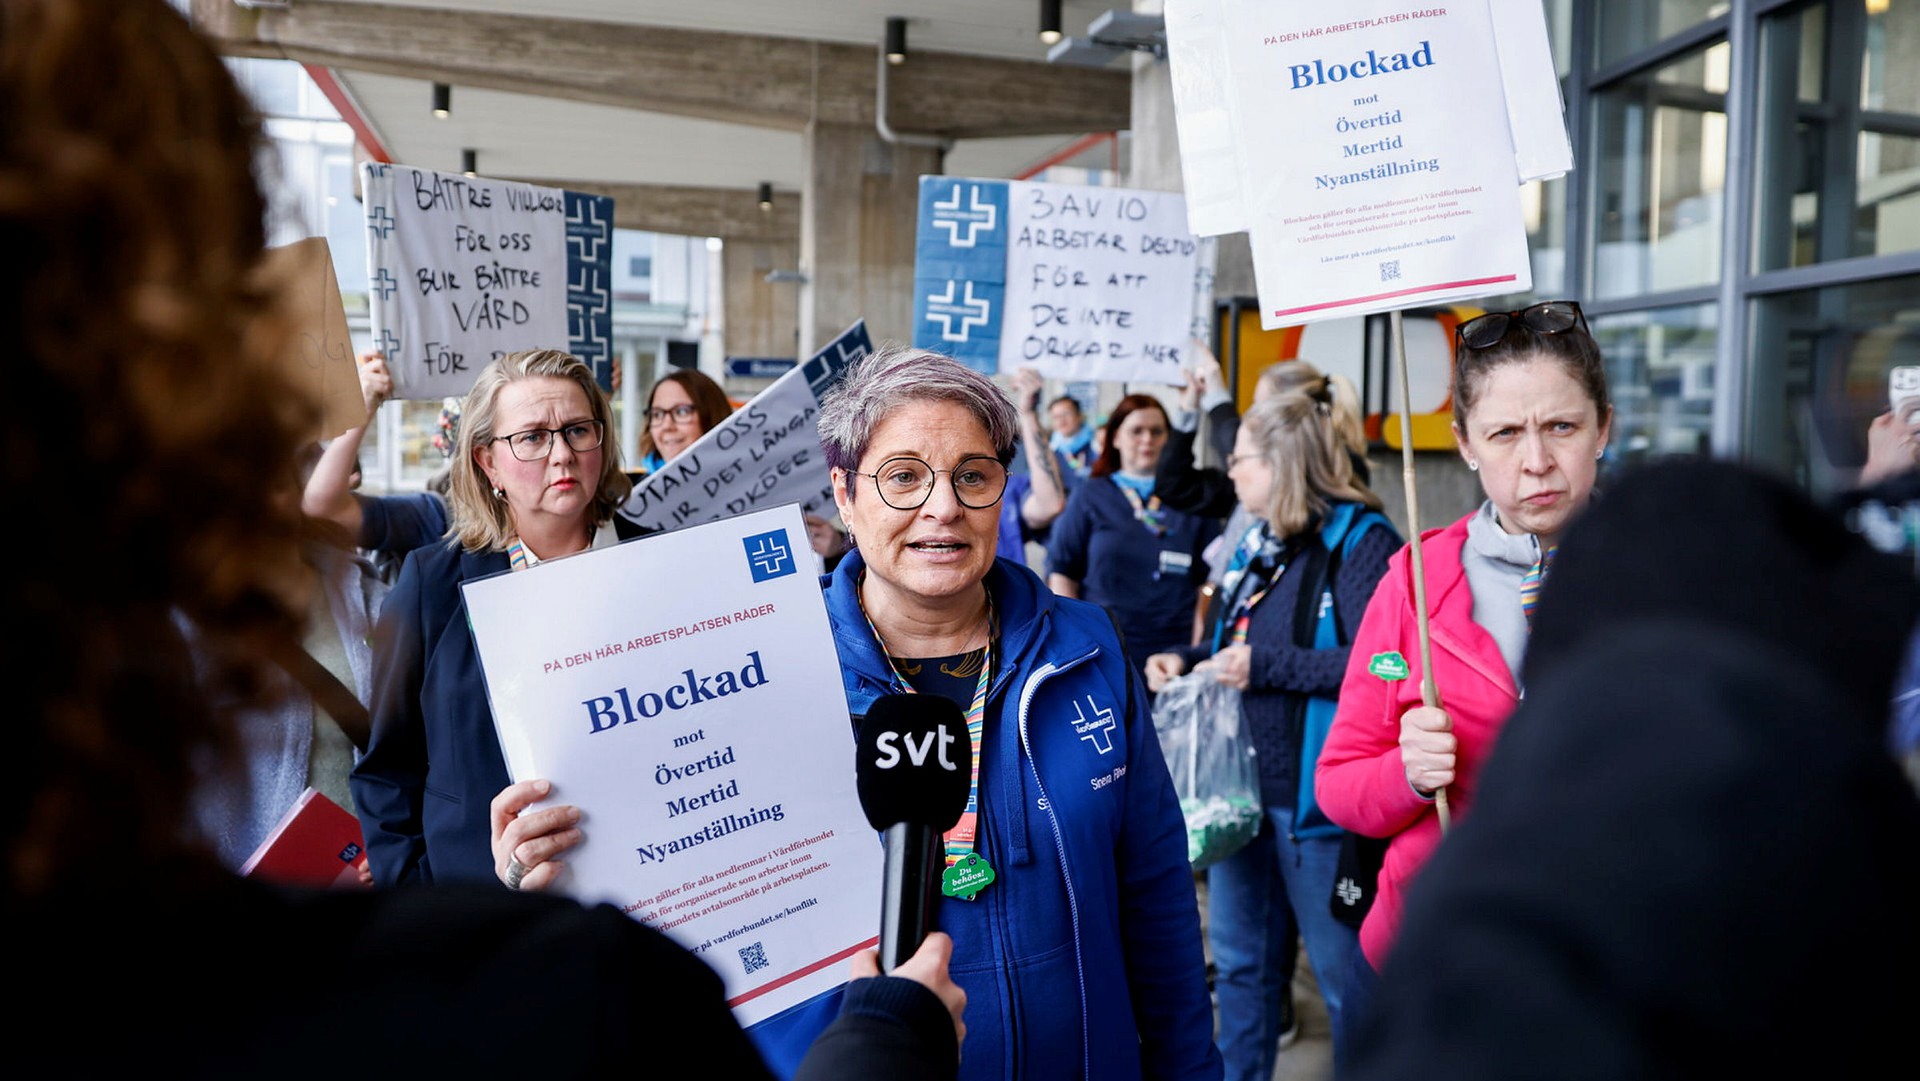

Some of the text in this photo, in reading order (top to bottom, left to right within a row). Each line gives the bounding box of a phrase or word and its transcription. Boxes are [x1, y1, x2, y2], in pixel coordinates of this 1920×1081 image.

[1279, 32, 1300, 43] DEN
[1325, 12, 1410, 34] ARBETSPLATSEN
[1288, 40, 1436, 90] Blockad
[1353, 93, 1379, 106] mot
[1336, 109, 1402, 133] Övertid
[1342, 135, 1403, 158] Mertid
[1315, 158, 1440, 190] Nyanställning
[1030, 189, 1148, 221] 3 AV 10
[455, 225, 531, 252] FÖR OSS
[1017, 226, 1127, 252] ARBETAR
[1334, 253, 1349, 262] mer
[416, 268, 461, 296] BLIR
[1032, 264, 1148, 291] FÖR ATT
[452, 292, 529, 332] VÅRD
[1031, 304, 1133, 329] DE INTE
[423, 342, 468, 376] FÖR
[1023, 335, 1180, 364] ORKAR MER
[622, 404, 767, 519] UTAN OSS
[703, 458, 743, 498] DET
[543, 603, 776, 674] PÅ DEN HÄR ARBETSPLATSEN RÅDER
[581, 650, 770, 734] Blockad
[673, 728, 706, 748] mot
[875, 724, 957, 771] svt
[655, 746, 736, 785] Övertid
[666, 779, 740, 818] Mertid
[636, 804, 785, 865] Nyanställning
[655, 887, 681, 904] gäller
[682, 880, 697, 892] för
[698, 875, 715, 887] alla
[716, 855, 768, 880] medlemmar
[773, 830, 835, 858] Vårdförbundet
[952, 870, 984, 886] behövs!
[959, 868, 972, 876] Du
[640, 852, 813, 924] och för oorganiserade som arbetar inom
[701, 889, 760, 916] avtalsområde
[761, 884, 773, 894] på
[773, 861, 831, 888] arbetsplatsen.
[700, 942, 712, 952] på
[713, 897, 818, 945] vardforbundet.se/konflikt
